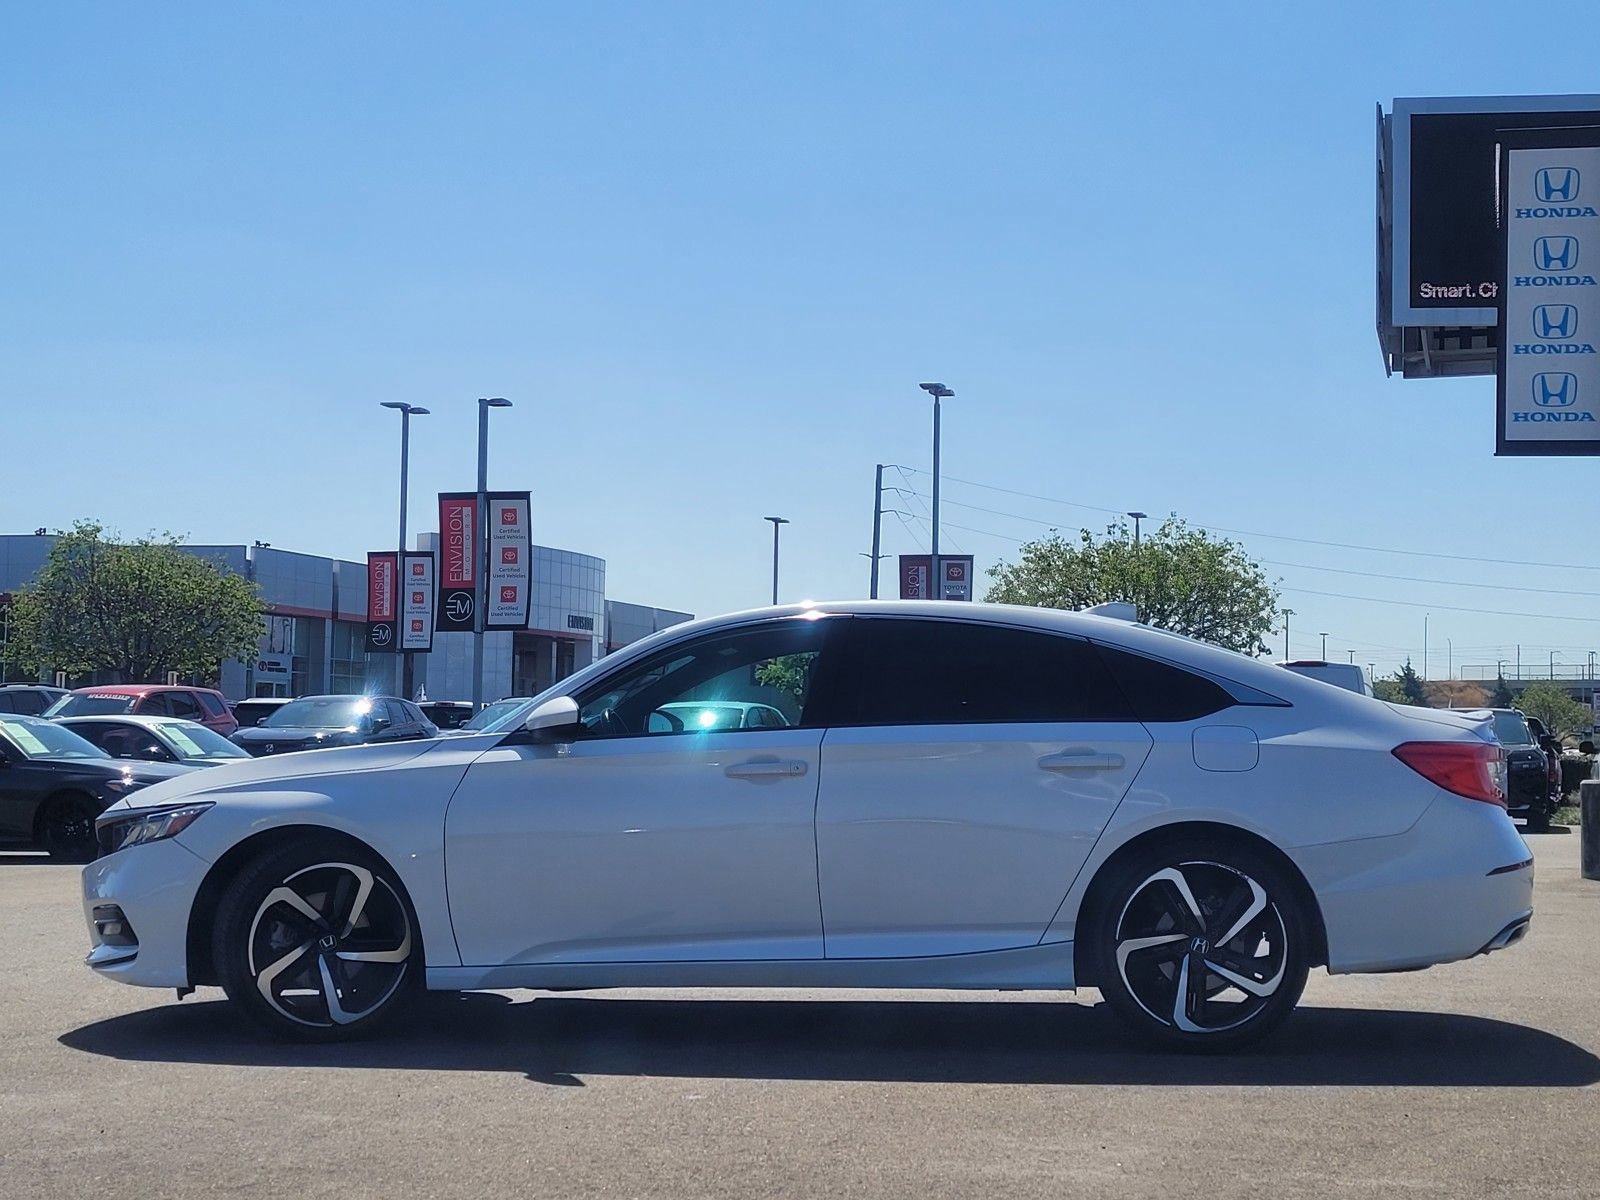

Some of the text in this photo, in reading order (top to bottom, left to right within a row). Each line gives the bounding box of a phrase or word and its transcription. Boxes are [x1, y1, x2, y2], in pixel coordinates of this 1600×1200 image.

[1515, 207, 1599, 219] HONDA
[1514, 275, 1598, 287] HONDA
[1420, 282, 1476, 298] Smart.
[1513, 344, 1597, 355] HONDA
[1512, 412, 1596, 422] HONDA
[449, 506, 463, 582] ENVISION
[374, 561, 384, 617] ENVISION
